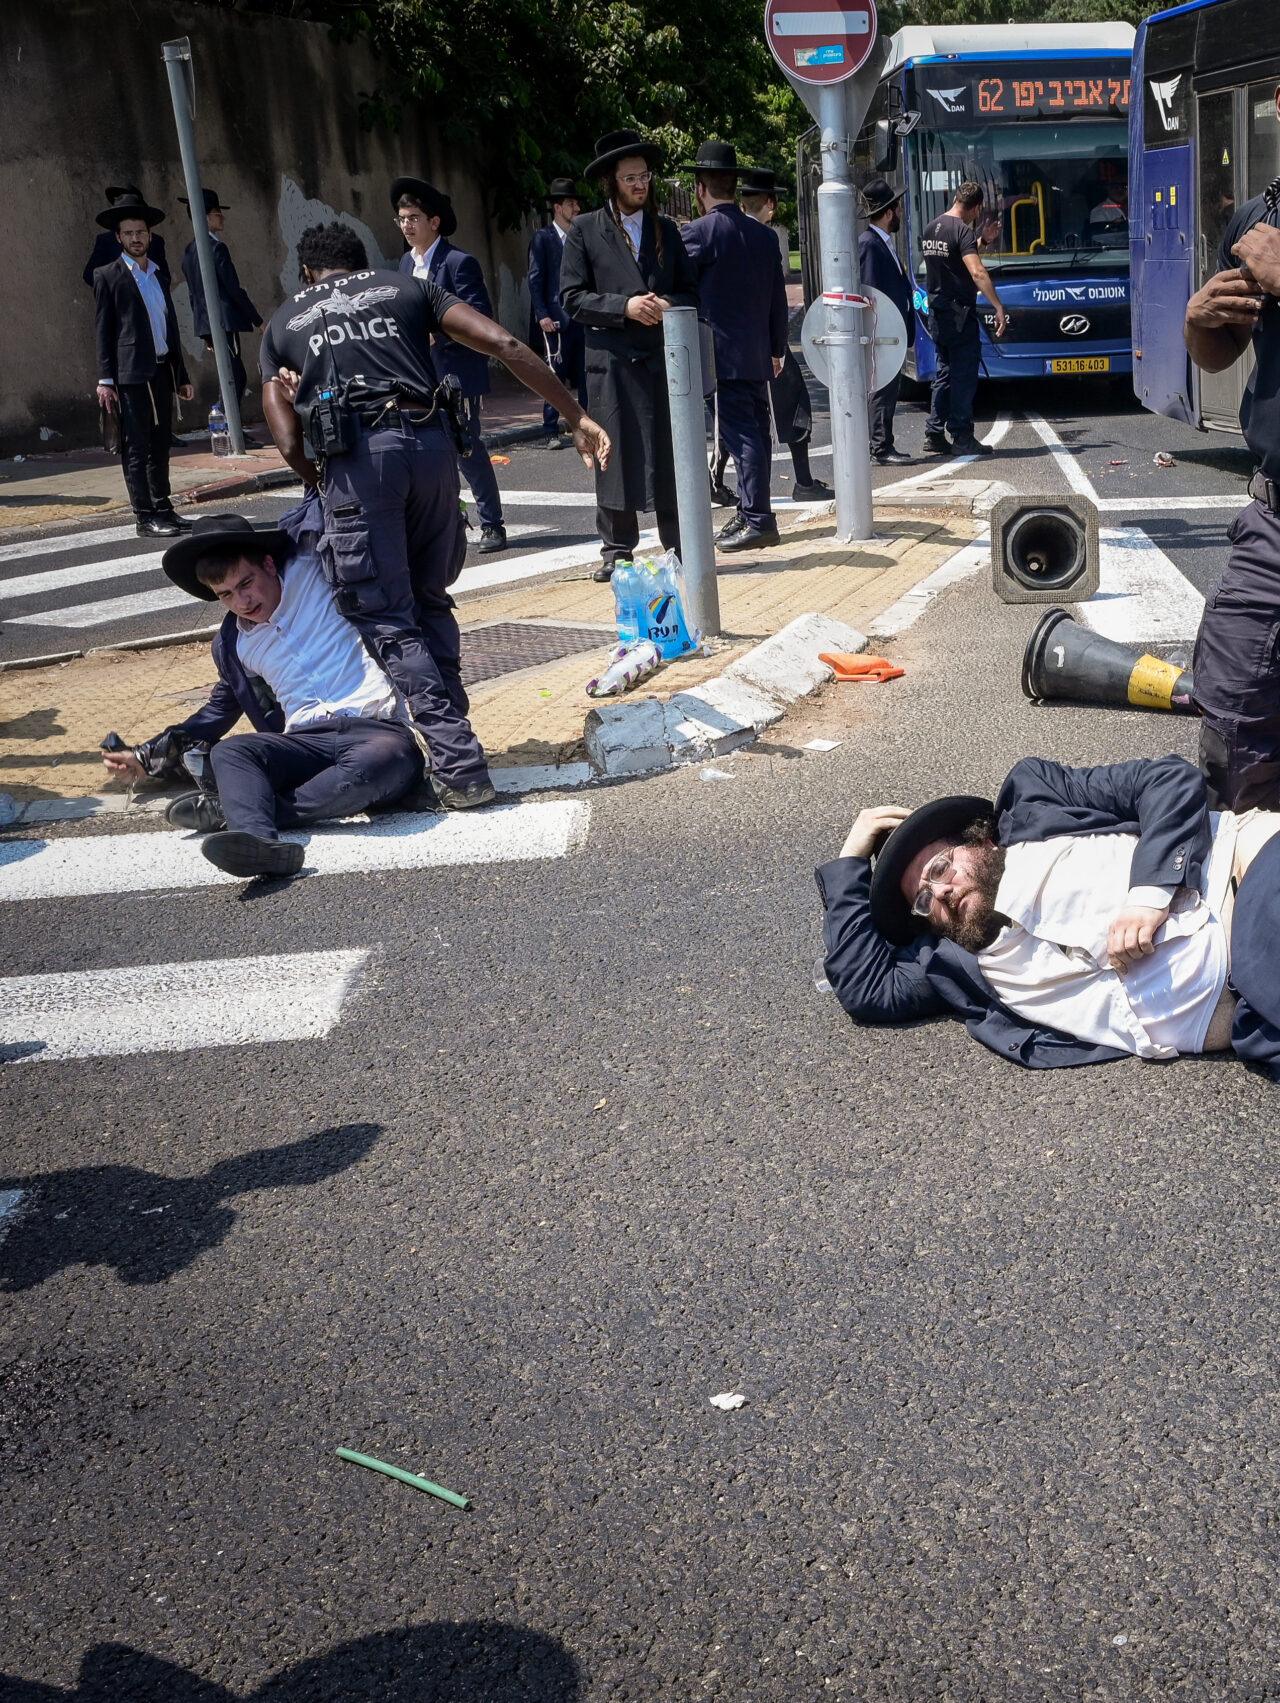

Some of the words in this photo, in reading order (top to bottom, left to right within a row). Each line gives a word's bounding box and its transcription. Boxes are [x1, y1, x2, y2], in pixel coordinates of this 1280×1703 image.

[978, 78, 1004, 111] 62
[1012, 81, 1044, 107] יפו
[1049, 80, 1103, 106] אביב
[1168, 116, 1179, 130] DAN
[922, 239, 949, 252] POLICE
[1033, 287, 1066, 302] חשמלי
[1088, 286, 1126, 299] אוטובוס
[984, 314, 1010, 324] 122
[308, 317, 400, 357] POLICE
